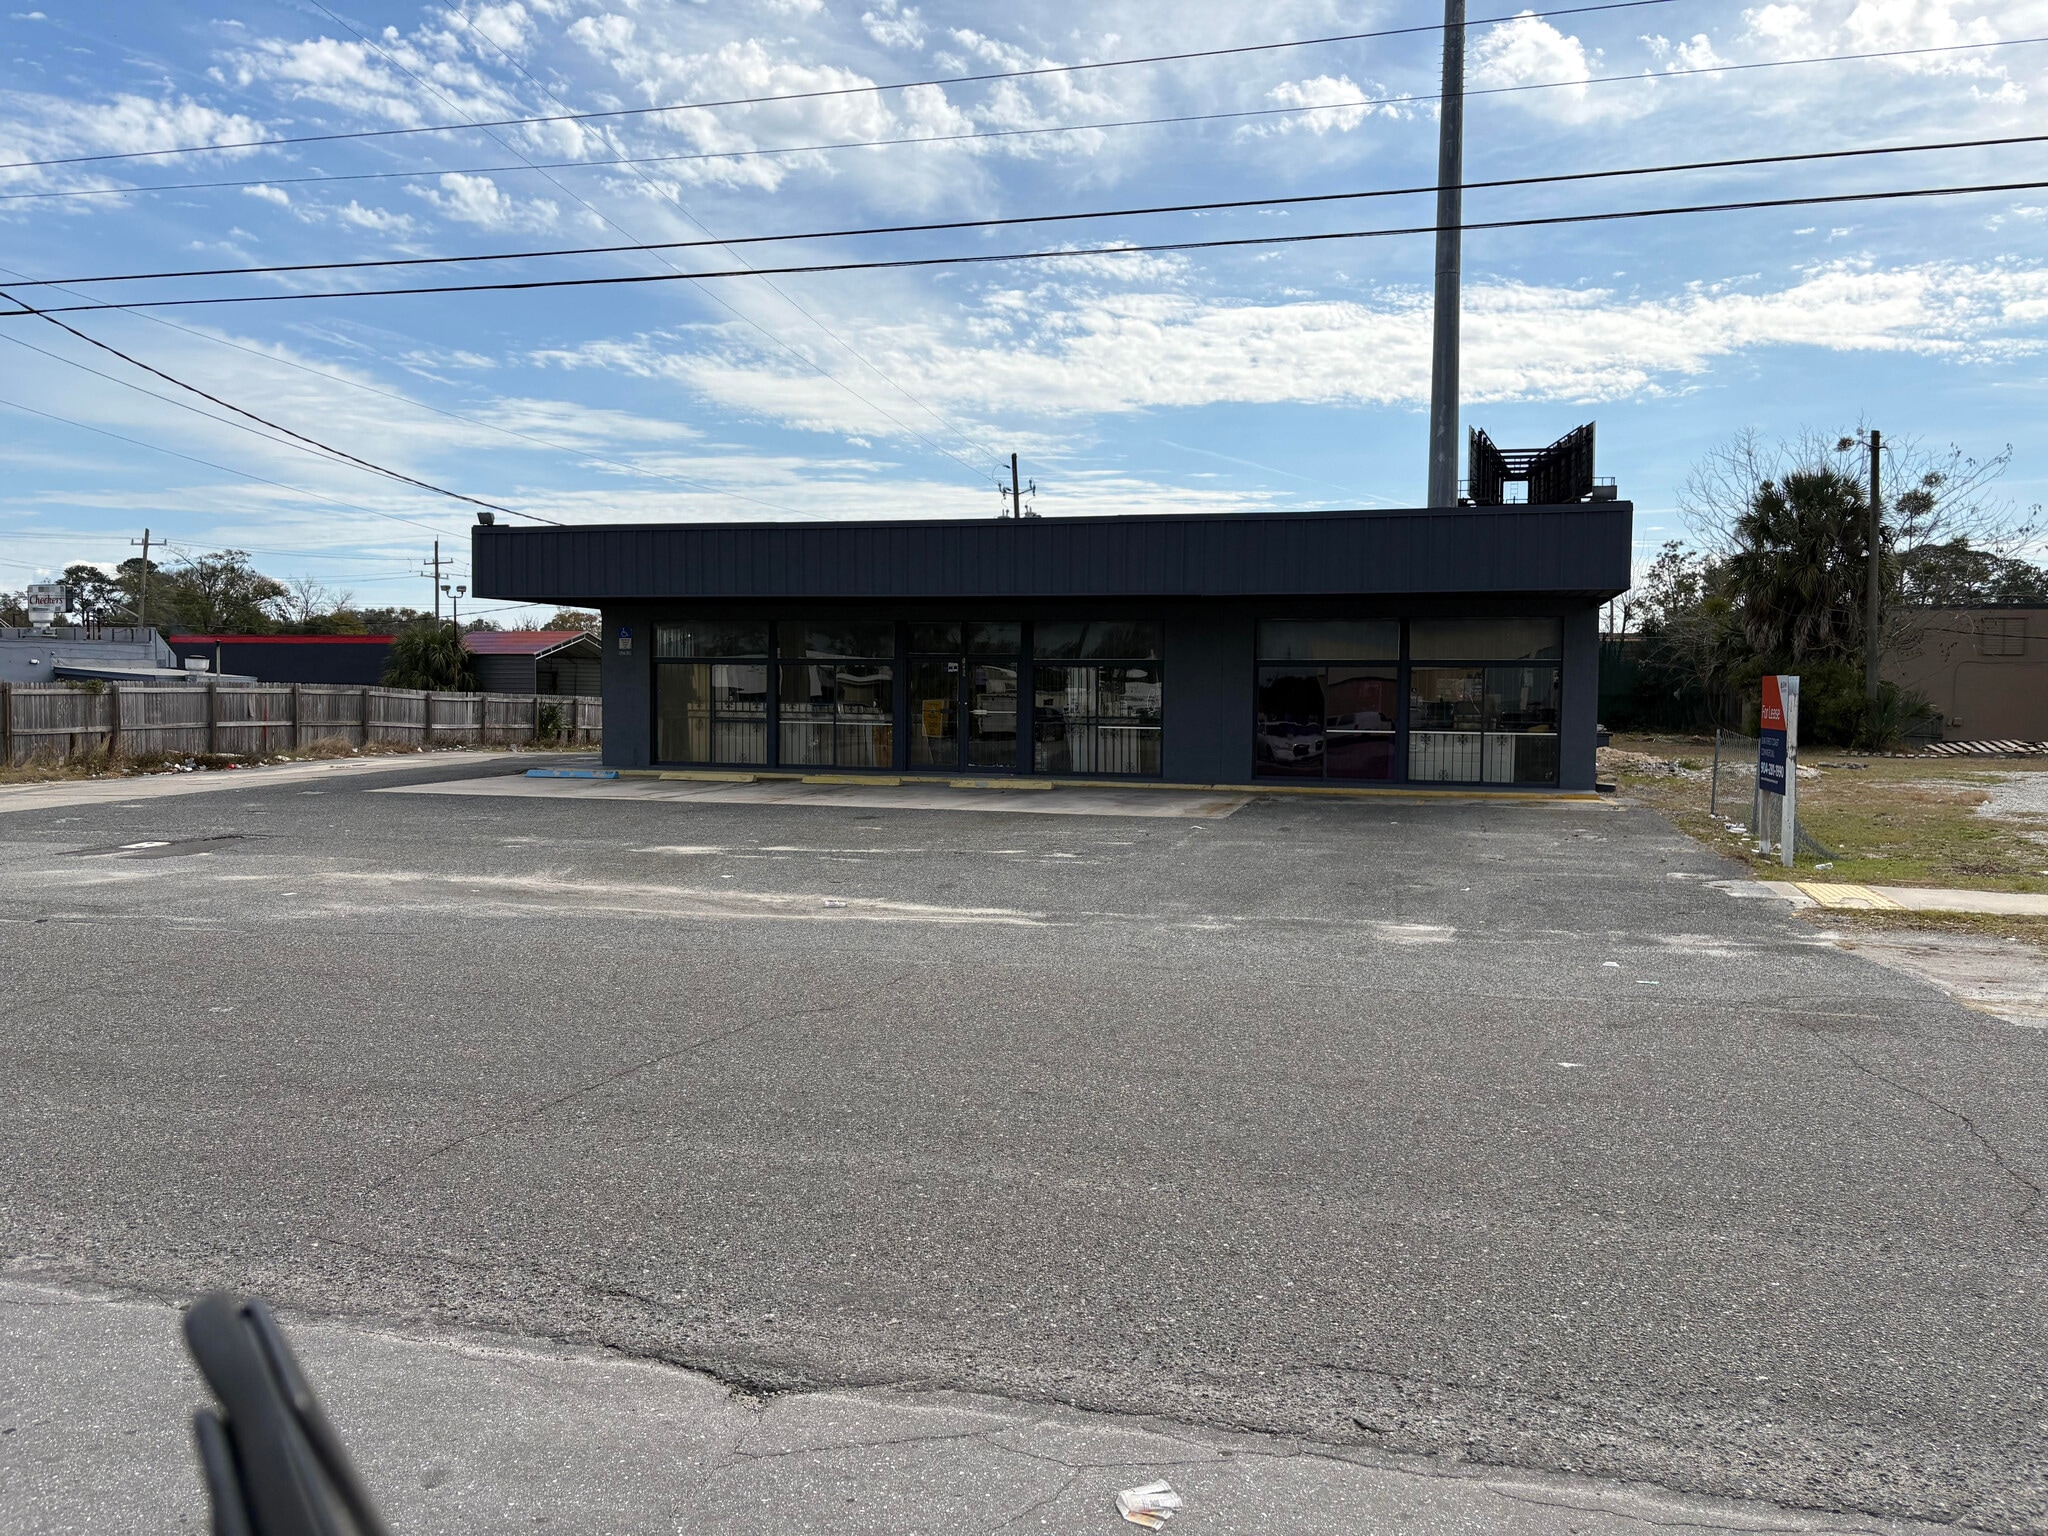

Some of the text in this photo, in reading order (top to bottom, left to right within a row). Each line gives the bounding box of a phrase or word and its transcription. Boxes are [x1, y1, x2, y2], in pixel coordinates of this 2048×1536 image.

[30, 594, 63, 605] Checkers
[1761, 705, 1780, 720] For Lease
